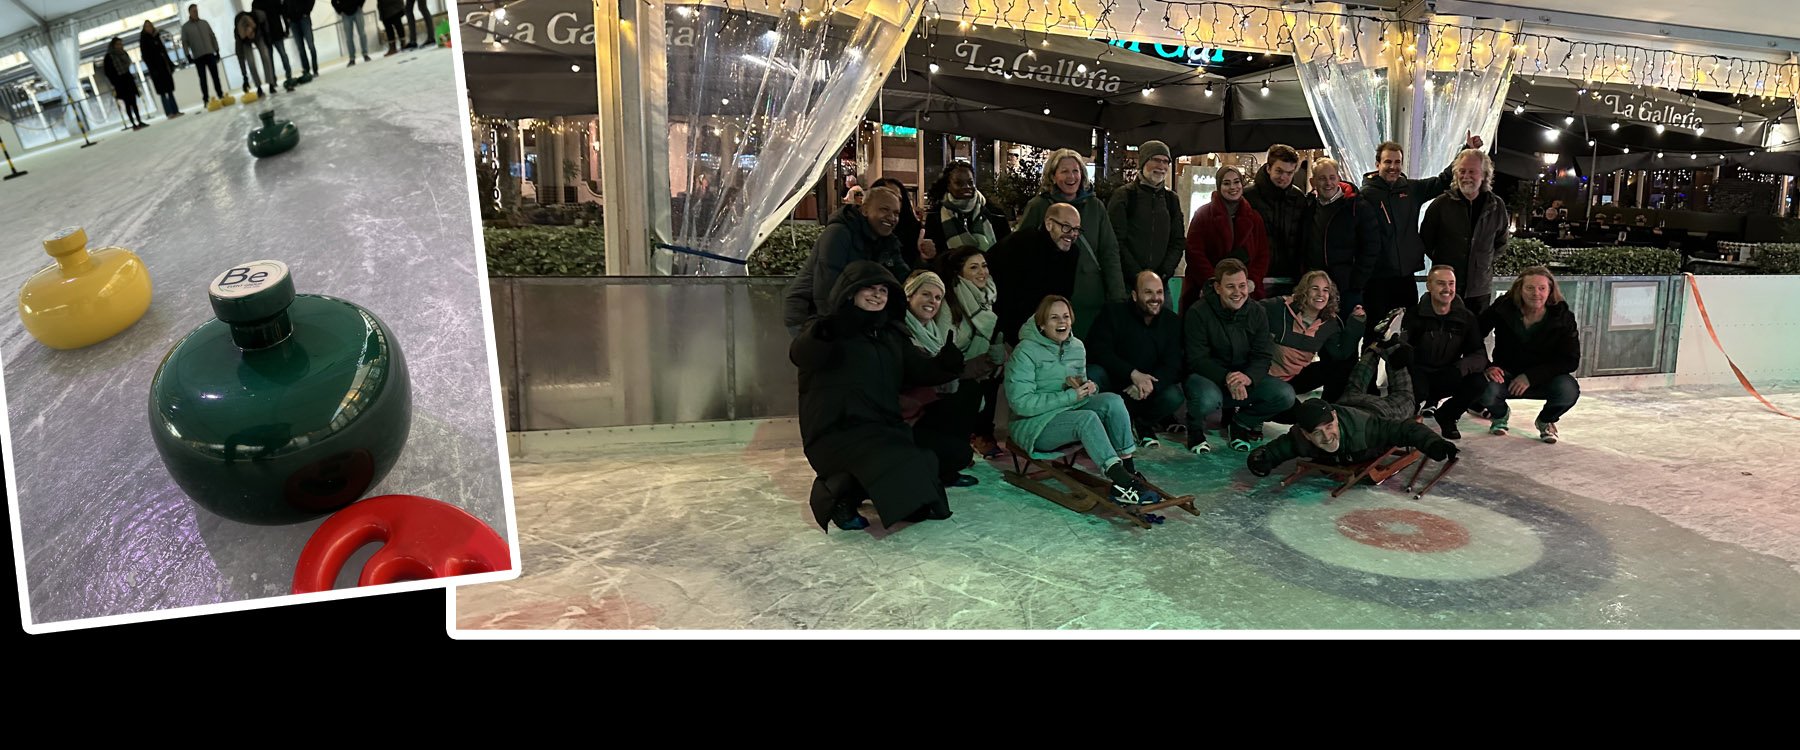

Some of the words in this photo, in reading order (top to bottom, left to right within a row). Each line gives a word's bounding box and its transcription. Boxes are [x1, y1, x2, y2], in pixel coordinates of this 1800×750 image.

[955, 42, 1004, 76] La
[1012, 52, 1121, 93] Galleria
[1604, 94, 1634, 118] La
[1638, 100, 1703, 131] Galleria
[218, 267, 268, 286] Be
